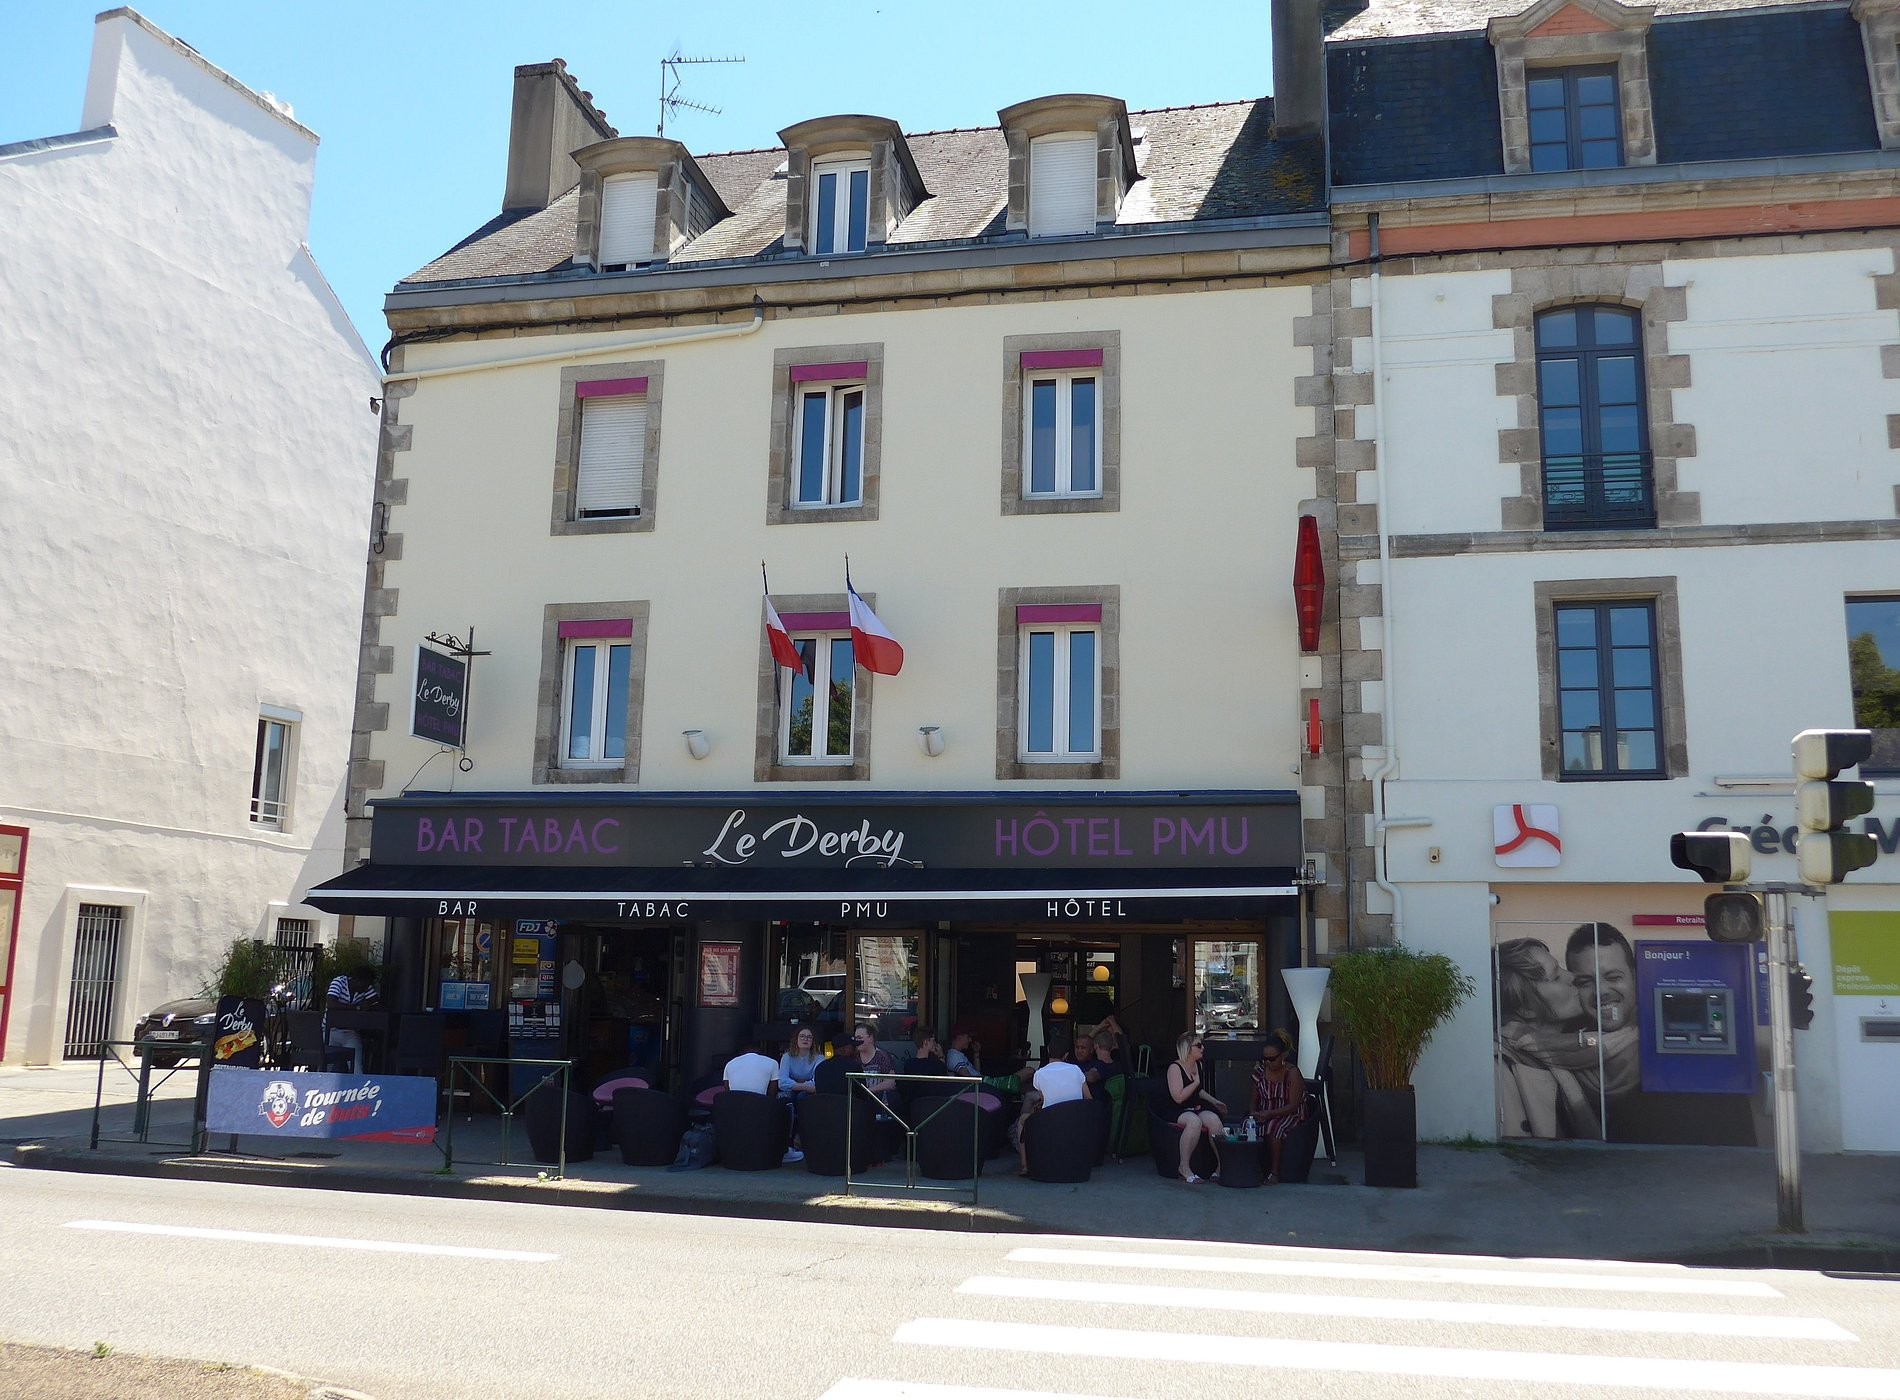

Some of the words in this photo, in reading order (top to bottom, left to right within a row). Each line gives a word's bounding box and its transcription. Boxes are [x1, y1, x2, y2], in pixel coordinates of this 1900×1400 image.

[417, 678, 430, 702] Le
[430, 685, 460, 717] Derby
[416, 817, 484, 853] BAR
[498, 817, 620, 855] TABAC
[703, 809, 756, 865] Le
[762, 814, 912, 869] Derby
[995, 810, 1134, 857] HÔTEL
[1153, 816, 1249, 856] PMU
[438, 900, 478, 916] BAR
[617, 902, 690, 918] TABAC
[840, 902, 889, 918] PMU
[1047, 898, 1126, 917] HÔTEL
[519, 922, 541, 932] FDJ
[1675, 915, 1706, 925] Retraits
[1644, 950, 1683, 961] Bonjour
[1685, 950, 1691, 960] !
[233, 1000, 245, 1019] Le
[220, 1012, 254, 1041] Derby
[303, 1079, 381, 1109] Tournée
[300, 1108, 326, 1127] de
[327, 1103, 371, 1124] buts
[371, 1099, 382, 1117] !
